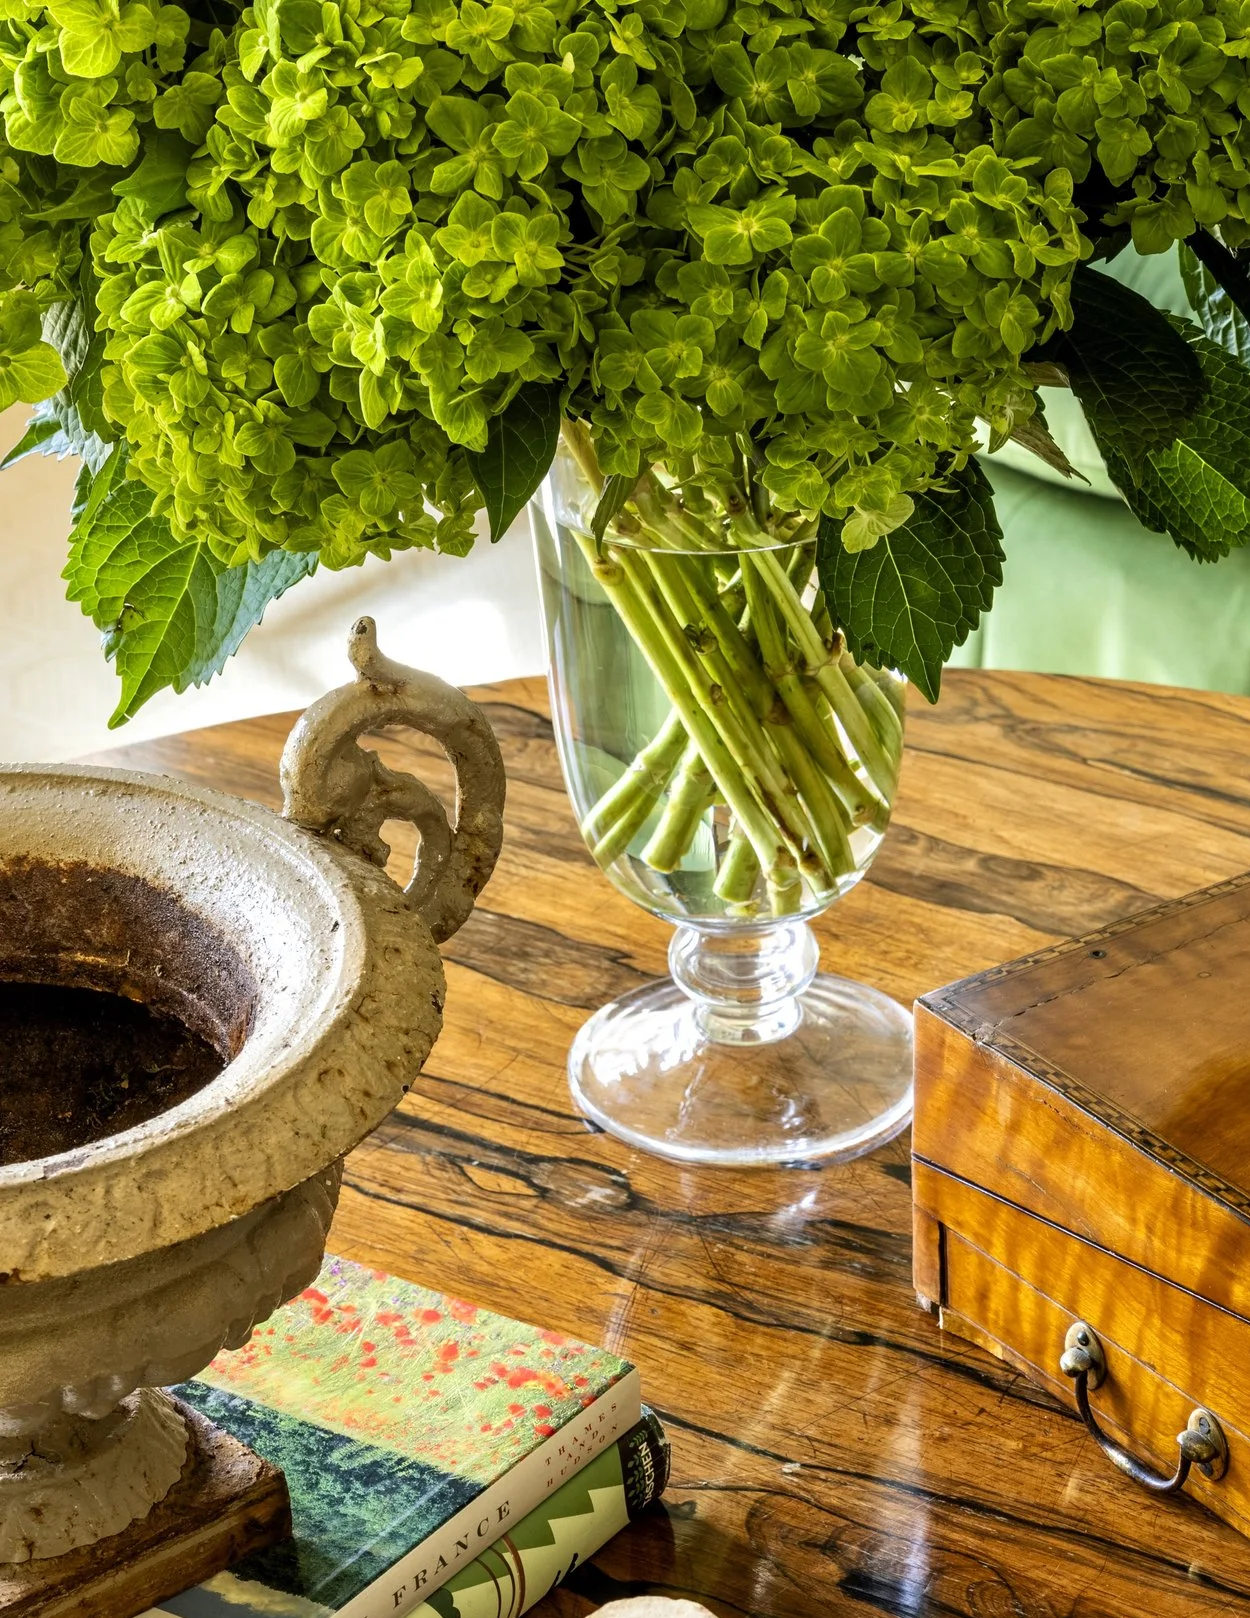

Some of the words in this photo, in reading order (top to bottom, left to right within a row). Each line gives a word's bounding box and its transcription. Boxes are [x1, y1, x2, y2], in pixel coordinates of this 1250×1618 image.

[545, 1402, 618, 1466] THAMES
[546, 1423, 619, 1488] HUDSON
[566, 1430, 599, 1462] AND
[639, 1441, 656, 1508] TASCHEN
[391, 1500, 512, 1609] FRANCE
